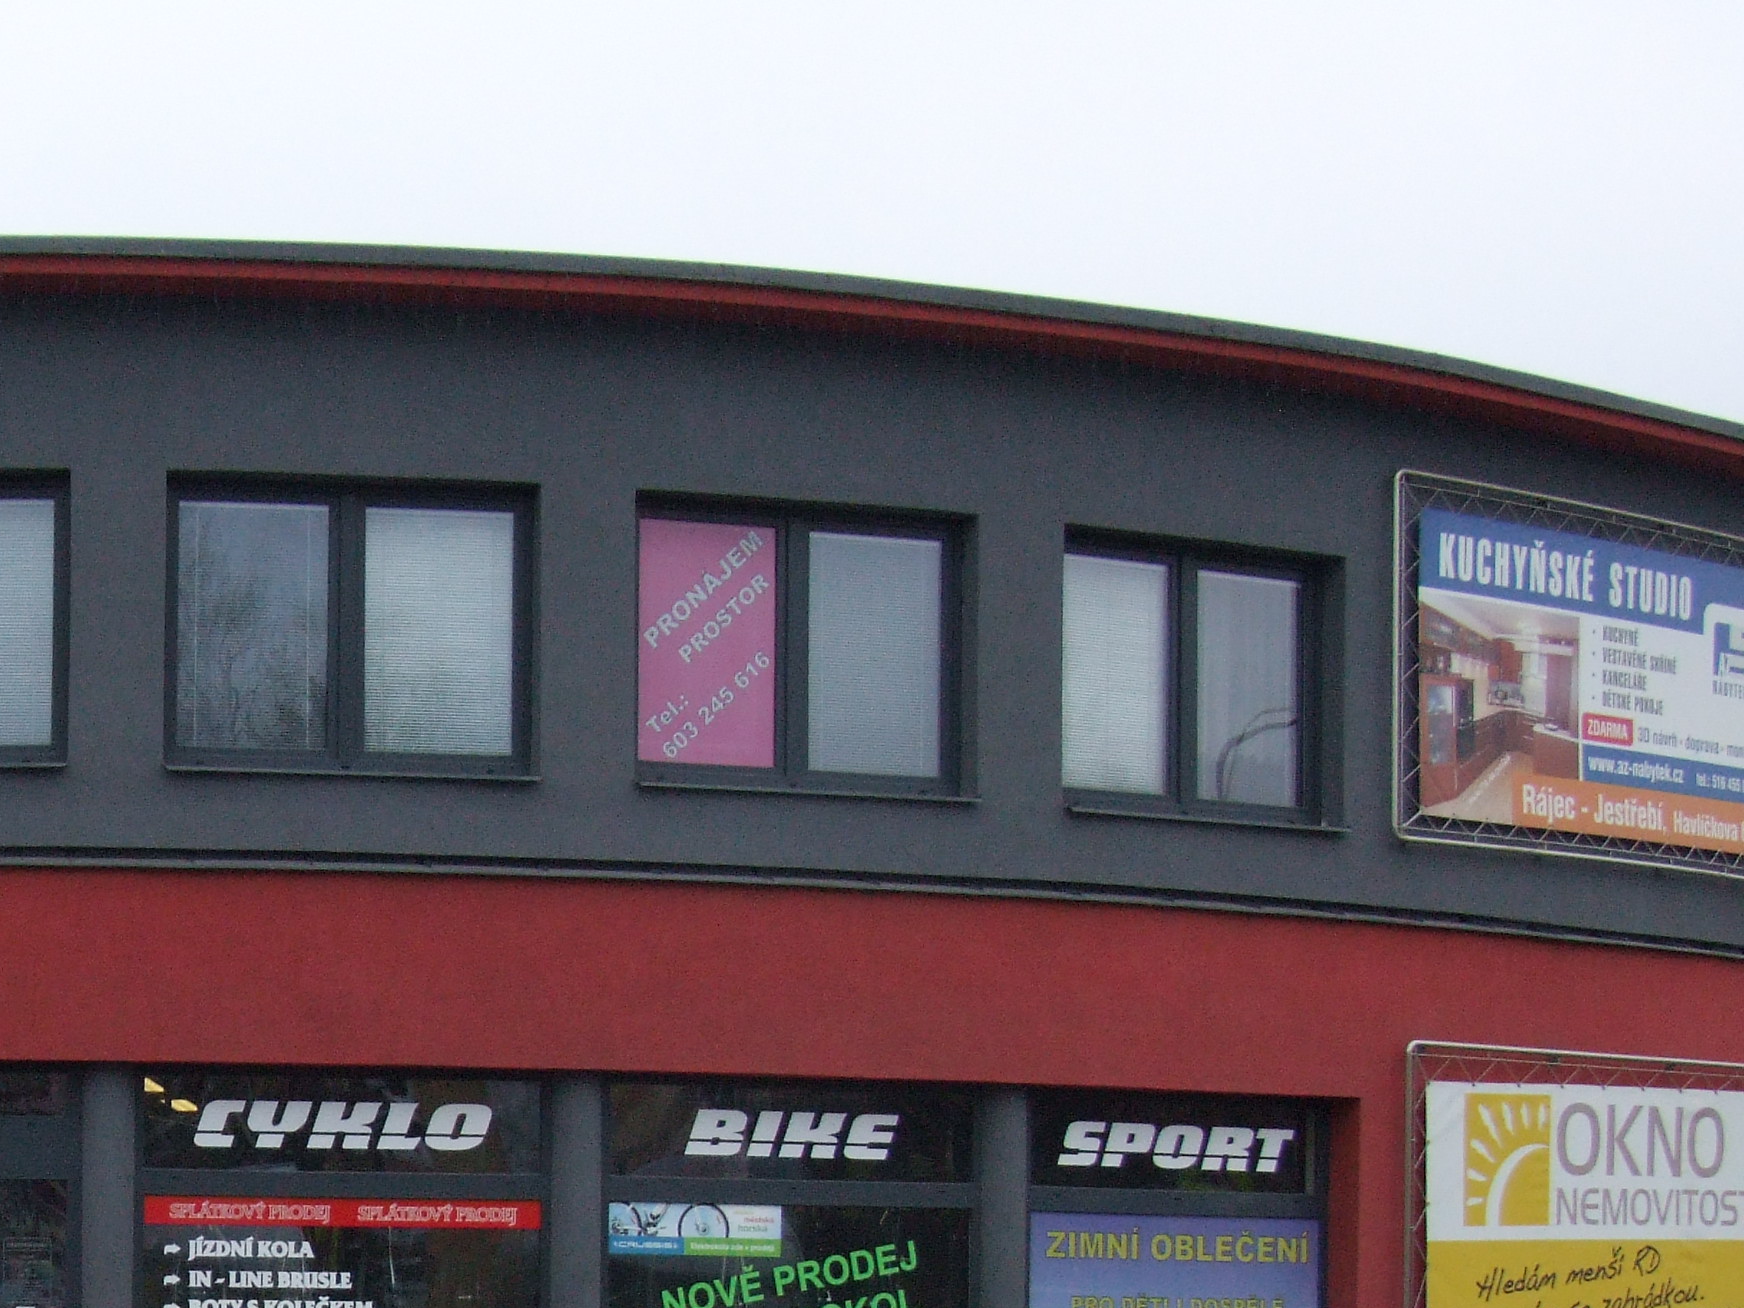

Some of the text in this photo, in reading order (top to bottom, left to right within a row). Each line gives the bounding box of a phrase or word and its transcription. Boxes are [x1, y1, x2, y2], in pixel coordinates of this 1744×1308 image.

[643, 531, 764, 648] PRONÁJEM
[1439, 532, 1692, 621] KUCHYŇSKÉ STUDIO
[678, 574, 770, 662] PROSTOR
[663, 652, 770, 758] 603 245 616
[1588, 719, 1628, 740] ZDARMA
[1522, 783, 1576, 824] Rájec
[194, 1099, 493, 1151] CYKLO
[684, 1108, 899, 1160] BIKE
[1057, 1120, 1297, 1173] SPORT
[1556, 1101, 1725, 1178] OKNO
[169, 1201, 518, 1226] SPLÁTKOVÝ PRODEJ SPLÁTKOVÝ PRODEJ
[1556, 1187, 1744, 1228] NEMOVITOS
[188, 1235, 315, 1261] JÍZDNÍ KOLA
[773, 1240, 917, 1296] PRODEJ
[1046, 1227, 1310, 1264] ZIMNÍ OBLEČENÍ
[188, 1270, 212, 1288] IN
[228, 1270, 274, 1289] LINE
[278, 1271, 353, 1289] BRUSLE
[1476, 1264, 1556, 1301] Hledám
[1565, 1246, 1624, 1286] menší
